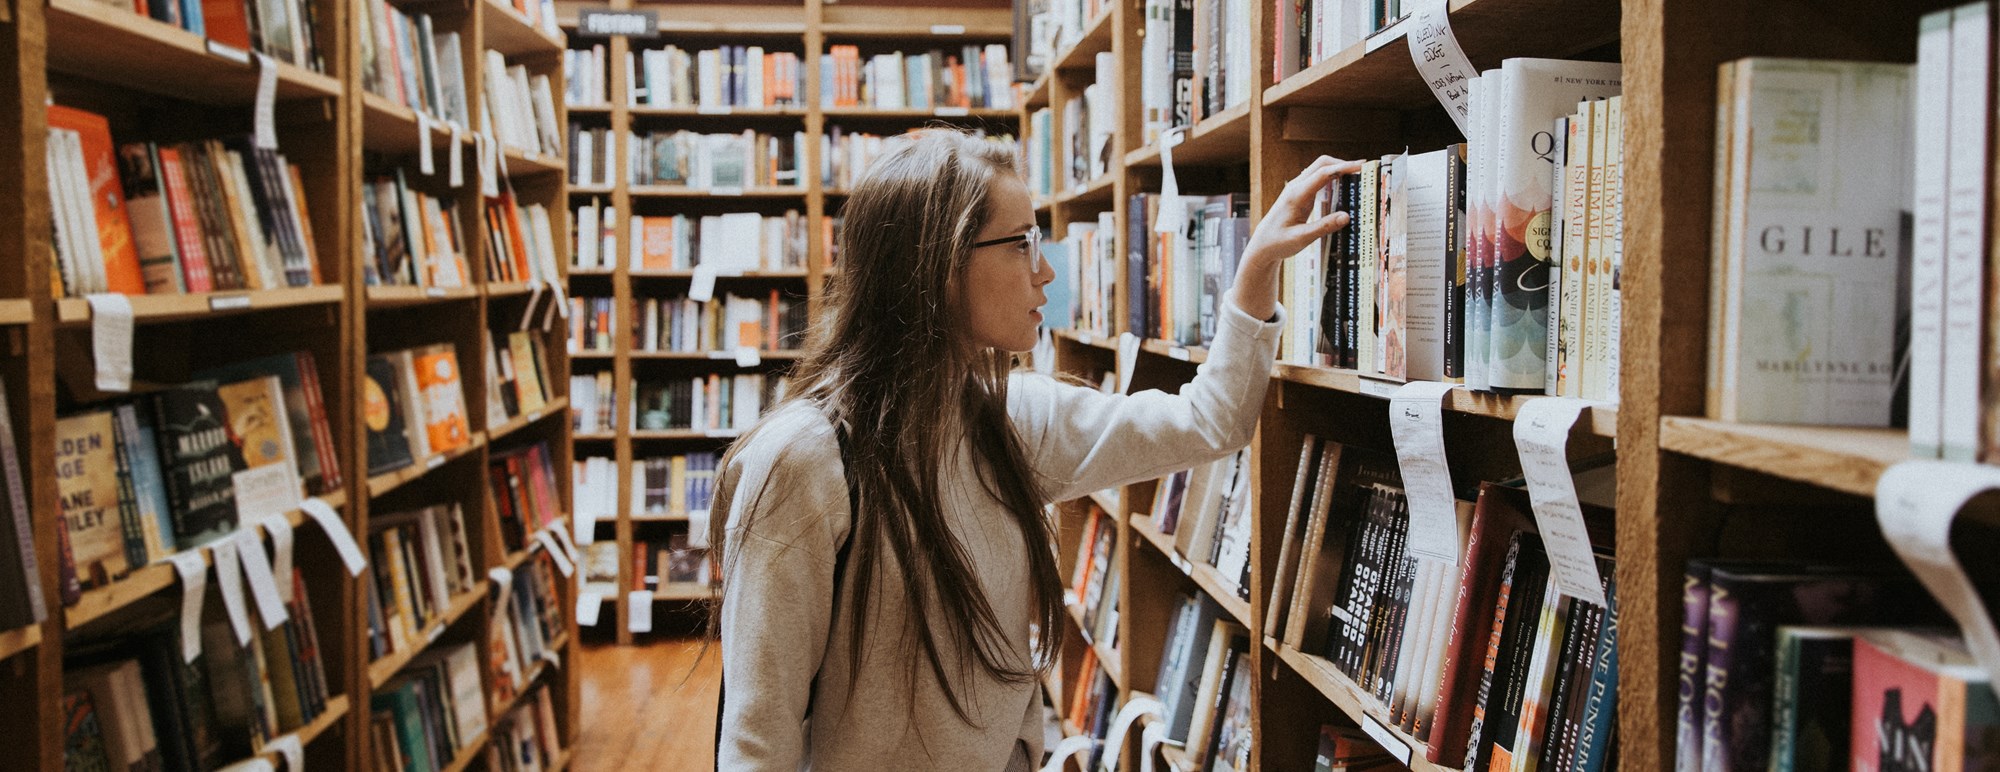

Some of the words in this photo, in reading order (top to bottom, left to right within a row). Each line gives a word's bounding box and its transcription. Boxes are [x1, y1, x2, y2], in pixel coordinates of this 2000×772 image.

[588, 13, 646, 34] FICTION
[1565, 77, 1582, 85] NEW
[1585, 78, 1605, 86] YORK
[1448, 155, 1456, 218] Monument
[1571, 165, 1585, 242] ISHMAEL
[1603, 163, 1616, 245] ISHMAEL
[1588, 166, 1602, 246] ISHMAEL
[1760, 224, 1887, 258] GILE
[1570, 279, 1578, 319] DANIEL
[1587, 283, 1596, 323] DANIEL
[1600, 282, 1609, 323] DANIEL
[1568, 321, 1577, 357] QUINN
[1585, 325, 1594, 362] QUINN
[1599, 325, 1608, 362] QUINN
[1463, 531, 1478, 570] Devil
[1461, 568, 1468, 580] in
[1347, 566, 1372, 641] OTARED
[1354, 570, 1379, 646] OTARED
[1390, 605, 1398, 624] Tom
[1446, 583, 1467, 646] Jerusalem
[1583, 608, 1593, 630] WHY
[1565, 618, 1578, 655] RAKHA
[1591, 612, 1601, 634] WHY
[1381, 626, 1393, 667] Rachman
[1389, 629, 1402, 671] Rachman
[1576, 638, 1587, 664] CAME
[1584, 643, 1595, 669] CAME
[1438, 656, 1451, 691] NAOMI
[1558, 678, 1566, 692] the
[1431, 694, 1443, 729] RAGEN
[1510, 681, 1521, 717] Childhood
[1542, 694, 1563, 763] CROCODILES
[1560, 718, 1570, 744] MARY
[1568, 723, 1579, 749] MARY
